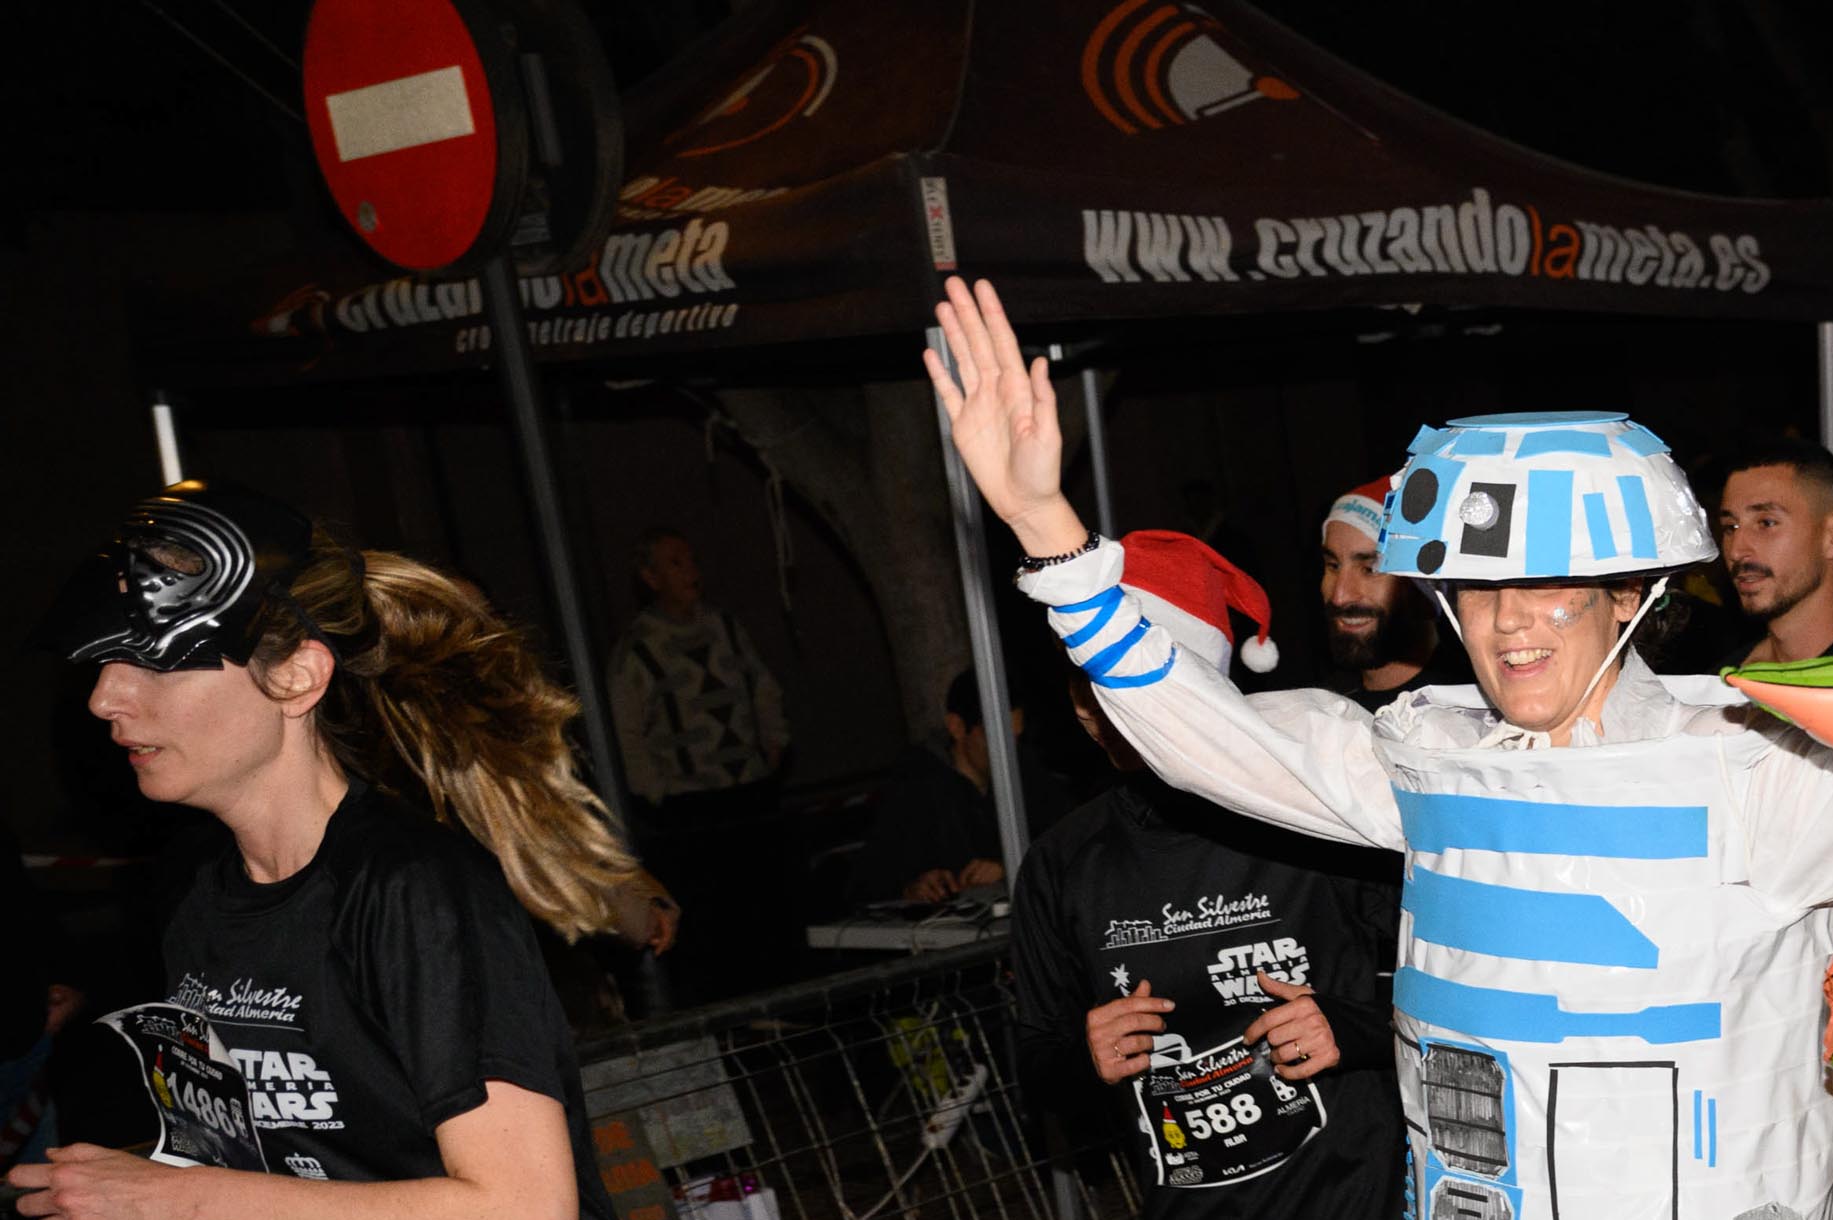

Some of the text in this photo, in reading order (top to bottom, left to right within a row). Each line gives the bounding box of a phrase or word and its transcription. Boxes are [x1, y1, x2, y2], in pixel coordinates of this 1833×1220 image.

[1162, 893, 1269, 926] San Silvestre
[1163, 917, 1213, 935] Ciudad
[1207, 937, 1307, 974] STAR
[226, 977, 303, 1009] Silvestre
[1175, 1048, 1250, 1081] San Silvestre
[1194, 1089, 1211, 1098] POR
[1211, 1084, 1223, 1093] TU
[1224, 1072, 1252, 1089] CIUDAD
[166, 1071, 237, 1138] 1486
[251, 1091, 339, 1120] ARS
[1185, 1093, 1262, 1139] 588
[311, 1120, 346, 1130] 2023
